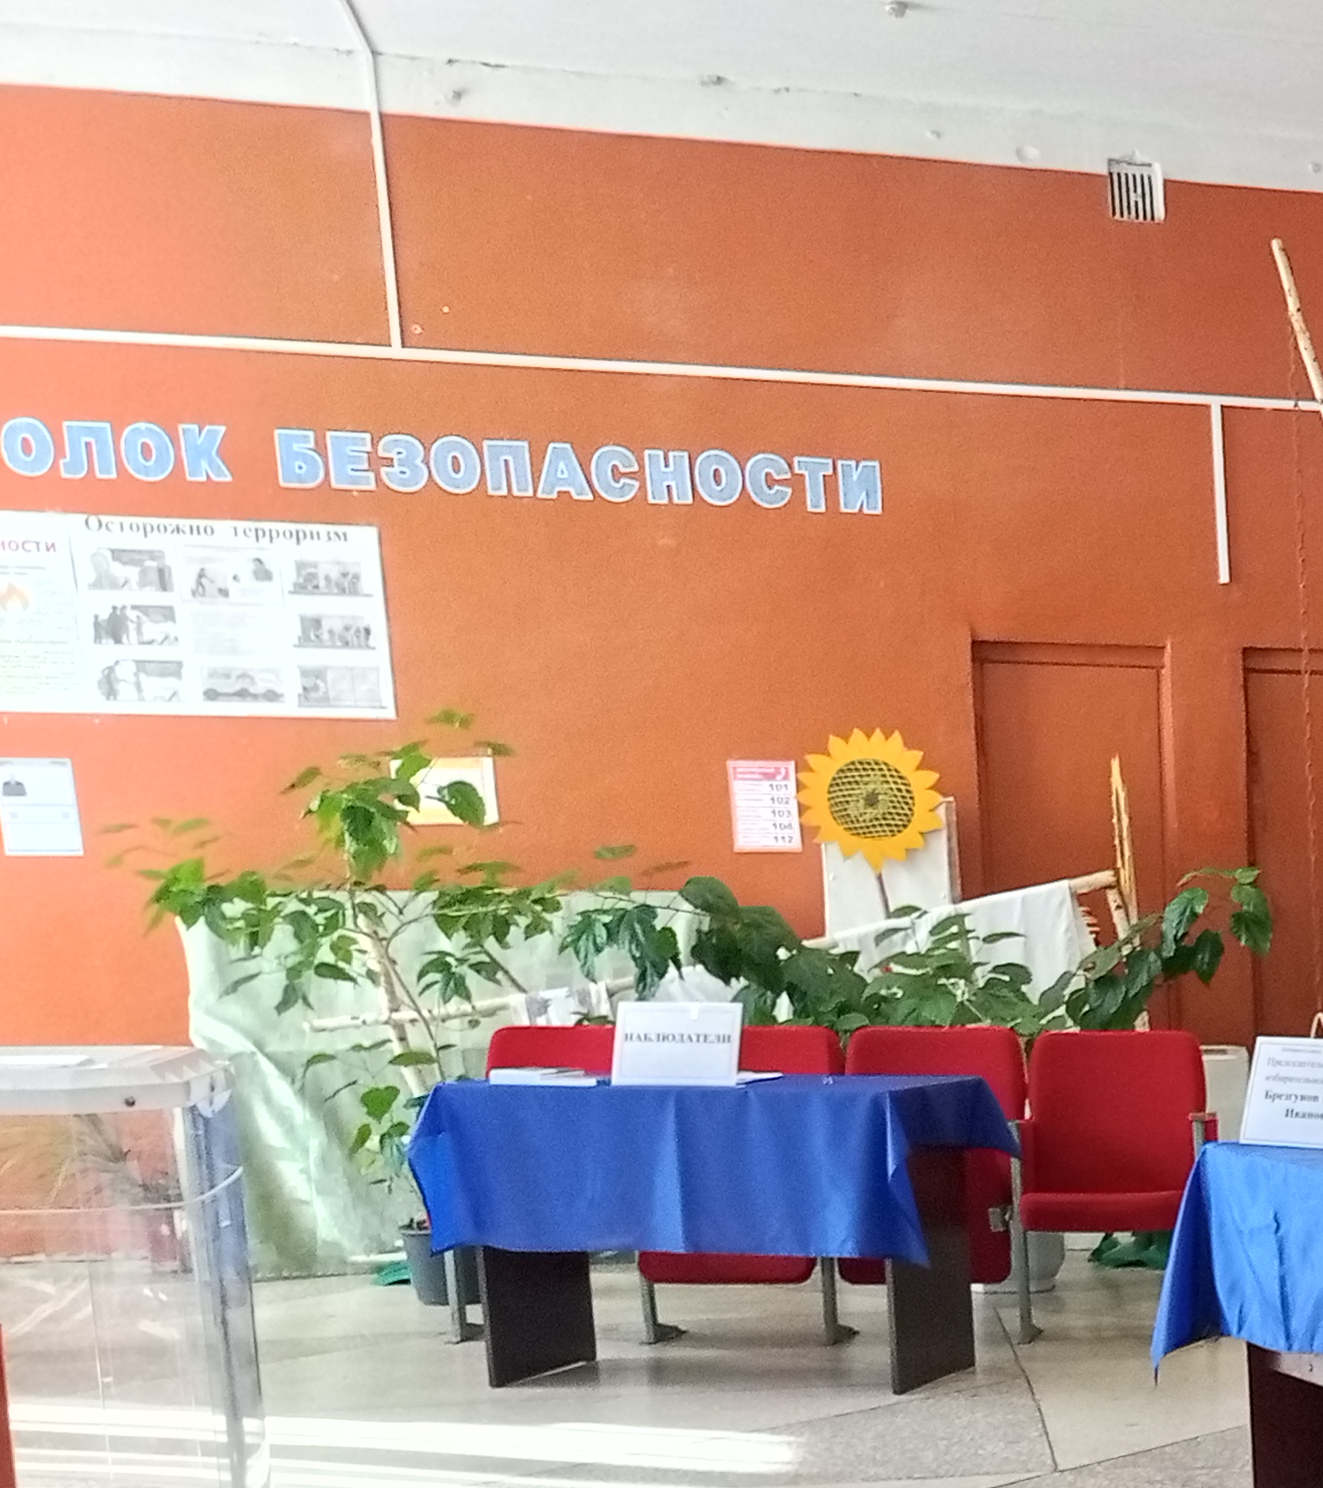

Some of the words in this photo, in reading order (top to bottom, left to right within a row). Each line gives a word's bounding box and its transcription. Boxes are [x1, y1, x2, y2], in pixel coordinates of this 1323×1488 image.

[1, 416, 232, 483] ОЛОК
[274, 427, 882, 515] БЕЗОПАСНОСТИ
[85, 514, 215, 539] Осторожно
[232, 523, 348, 545] терроризм
[624, 1033, 731, 1043] НАБЛЮДАТЕЛИ
